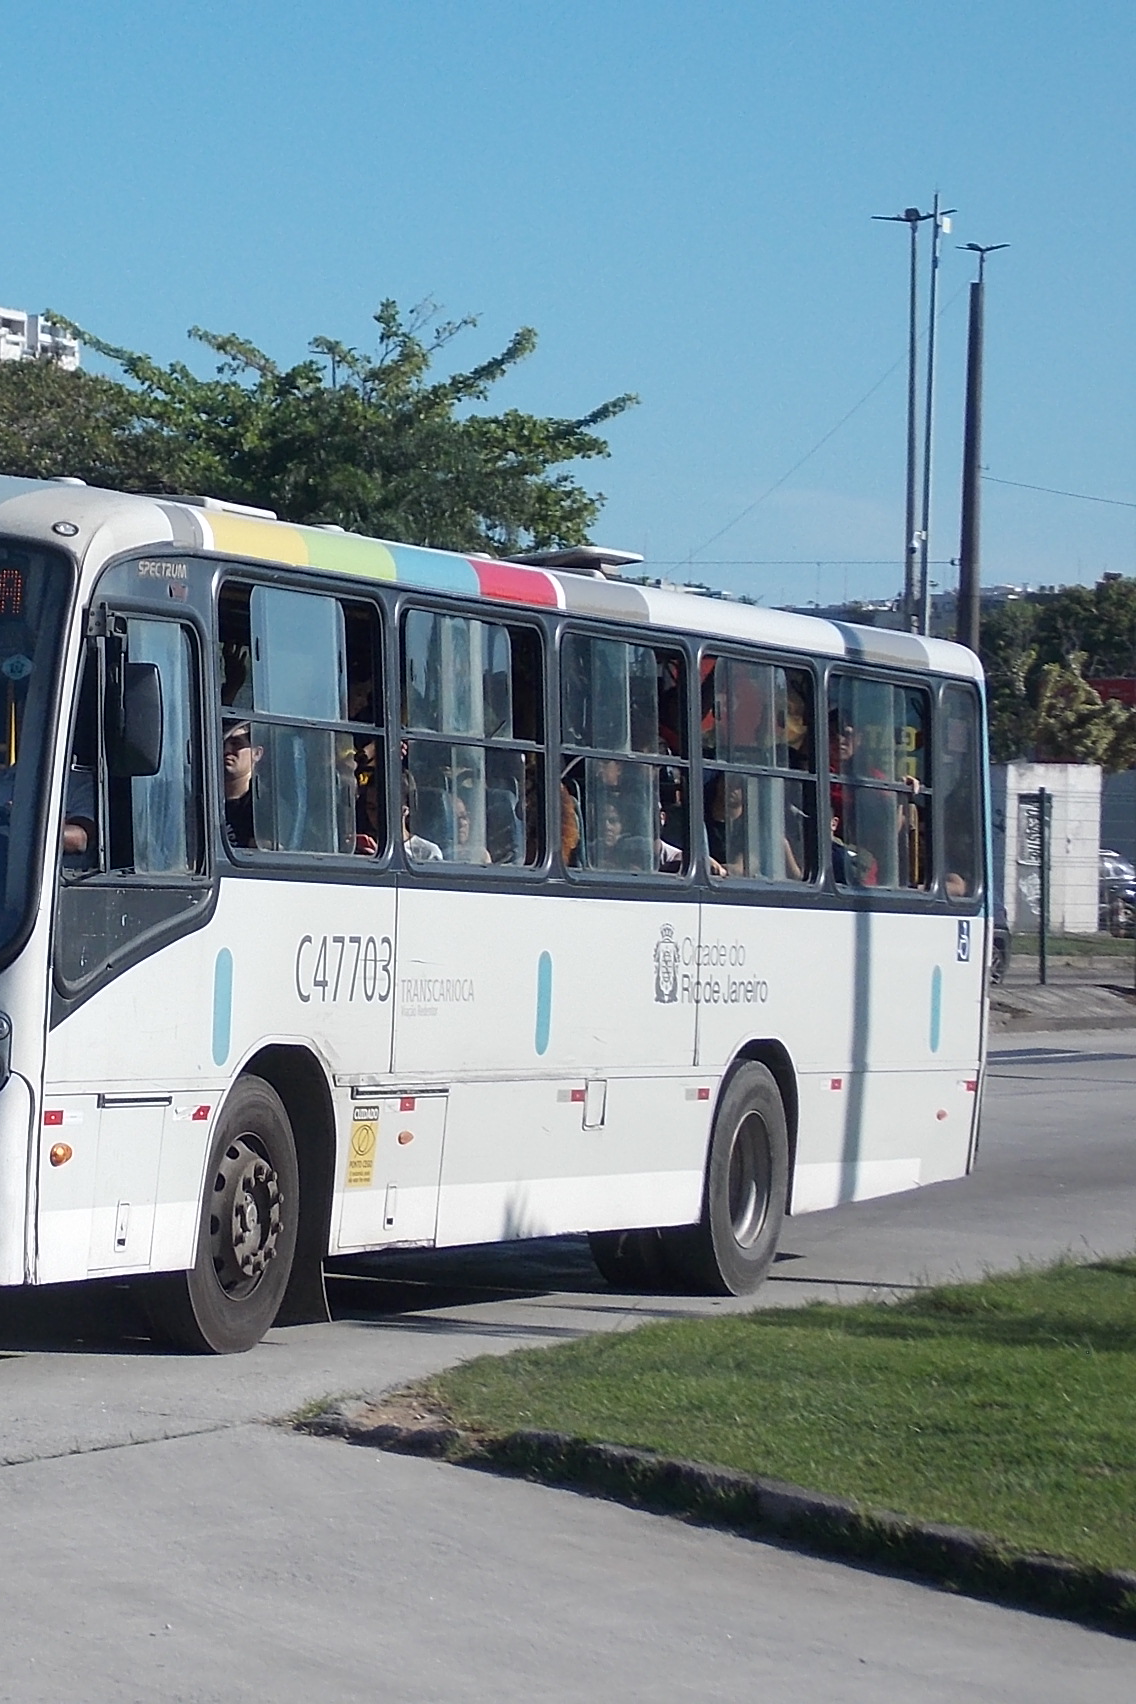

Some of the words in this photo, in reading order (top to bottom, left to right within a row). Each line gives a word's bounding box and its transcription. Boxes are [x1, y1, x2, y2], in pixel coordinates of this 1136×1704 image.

[138, 561, 187, 579] SPECTRUM
[682, 937, 727, 966] Cidade
[729, 938, 745, 966] do
[296, 935, 392, 1002] C47703
[401, 979, 474, 1003] TRANSCARIOCA
[682, 973, 702, 1003] Rio
[703, 973, 721, 1003] de
[722, 973, 768, 1004] Janeiro
